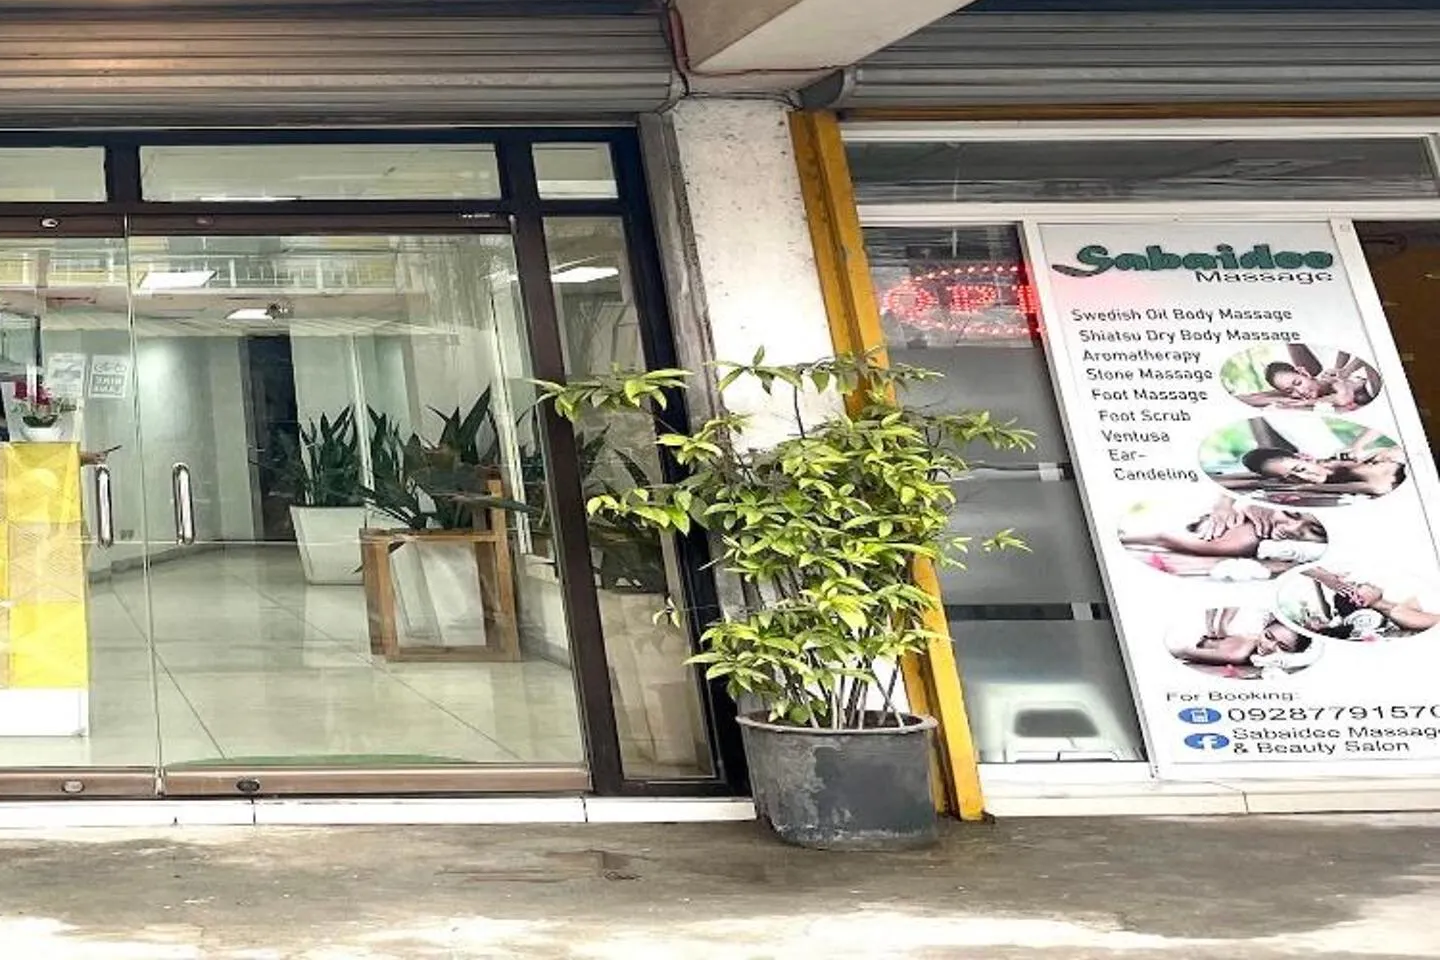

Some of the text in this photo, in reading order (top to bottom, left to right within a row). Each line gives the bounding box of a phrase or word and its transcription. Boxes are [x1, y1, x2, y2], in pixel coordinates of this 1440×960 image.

[1194, 270, 1333, 284] Massage
[1071, 308, 1293, 324] Swedish Oil Body Massage
[1078, 329, 1301, 344] Shiatsu Dry Body Massage
[1082, 349, 1201, 364] Aromatherapy
[1086, 368, 1213, 382] Stone Massage
[1091, 389, 1209, 403] Foot Massage
[1098, 409, 1192, 422] Foot Scrub
[1100, 430, 1171, 443] Ventusa
[1109, 449, 1147, 462] Ear-
[1113, 468, 1200, 483] Candeling
[1167, 692, 1199, 702] For
[1232, 726, 1440, 740] Sabaidee Massag
[1233, 740, 1410, 755] & Beauty Salon
